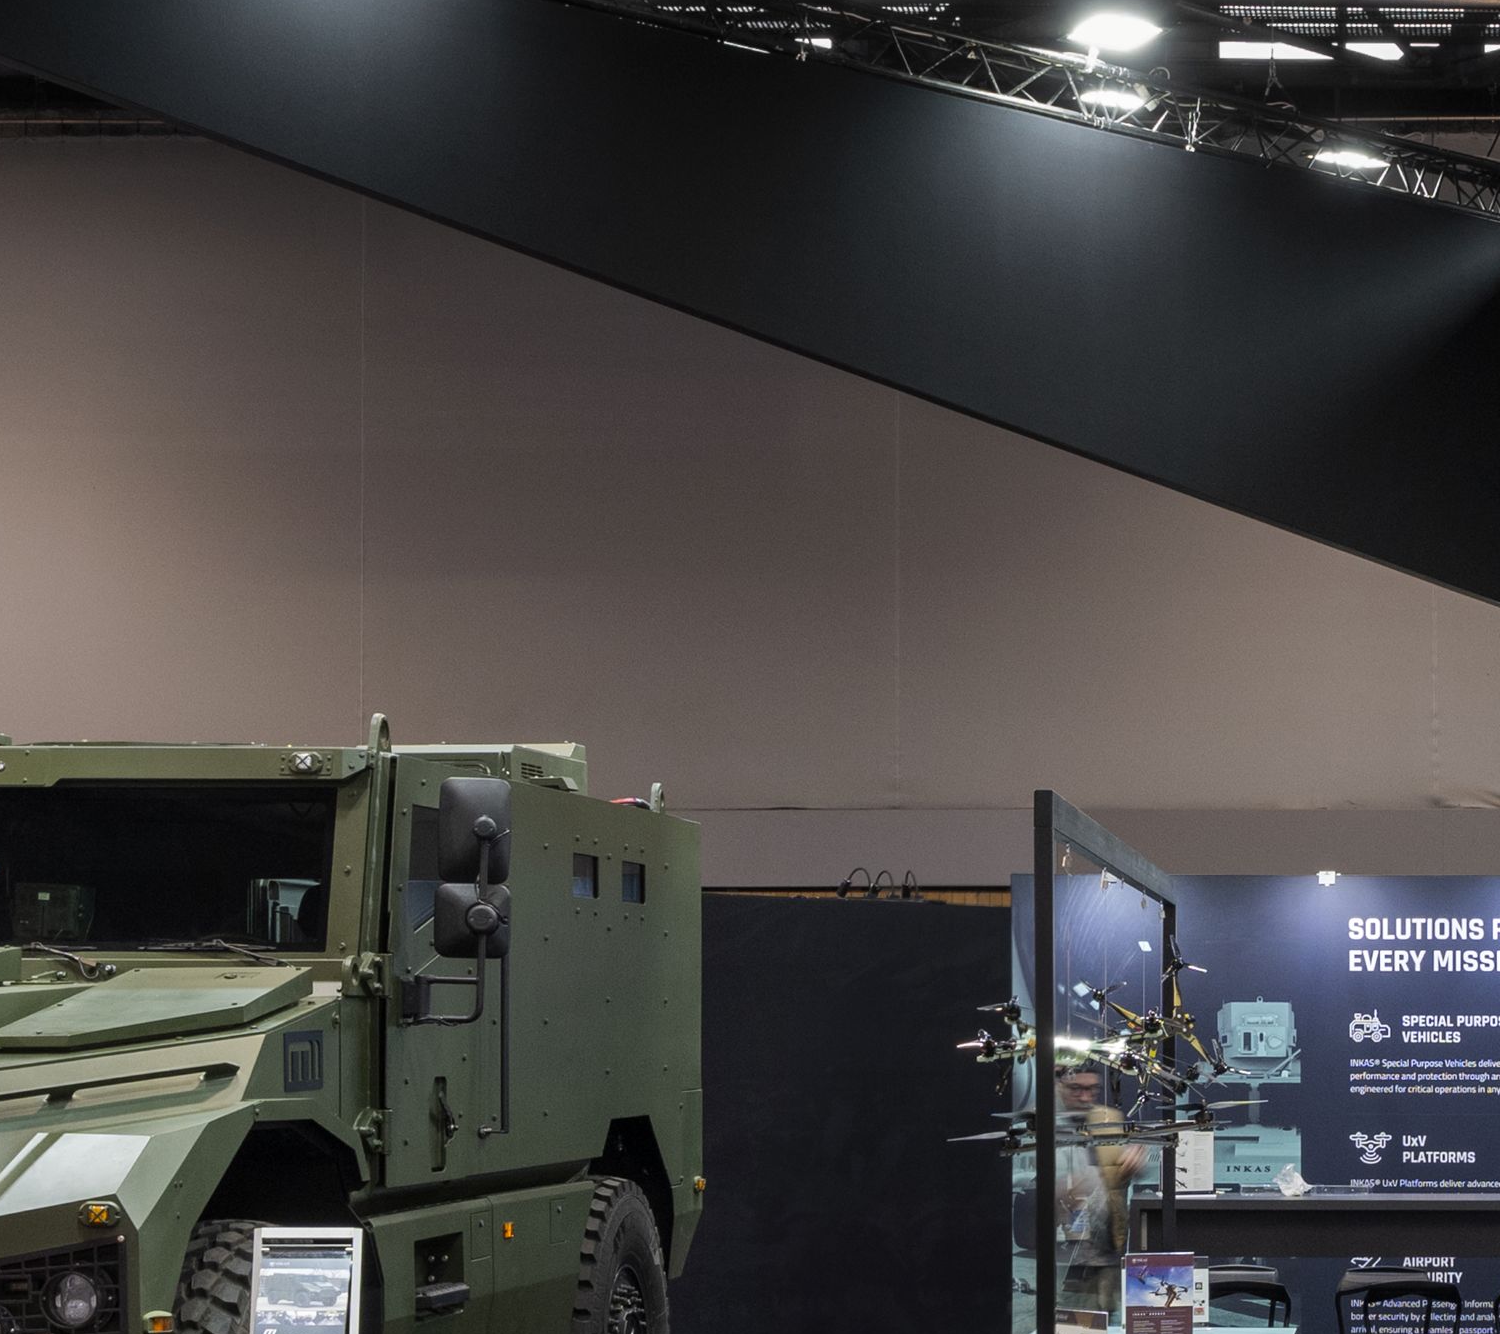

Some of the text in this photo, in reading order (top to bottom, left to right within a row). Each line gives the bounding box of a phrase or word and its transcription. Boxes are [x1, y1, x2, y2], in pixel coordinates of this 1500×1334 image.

[1348, 917, 1485, 941] SOLUTIONS
[1349, 950, 1427, 972] EVERY
[1402, 1015, 1454, 1027] SPECIAL
[1402, 1031, 1461, 1043] VEHICLES
[1381, 1059, 1410, 1070] Special
[1411, 1059, 1444, 1070] Purpose
[1444, 1059, 1477, 1068] Vehicles
[1350, 1072, 1400, 1083] performance
[1401, 1072, 1416, 1081] and
[1417, 1072, 1458, 1083] protection
[1458, 1072, 1490, 1083] through
[1350, 1085, 1394, 1096] engineered
[1395, 1085, 1407, 1094] for
[1408, 1085, 1434, 1094] critical
[1434, 1085, 1477, 1095] operations
[1478, 1085, 1486, 1094] in
[1486, 1087, 1500, 1096] any
[1402, 1134, 1427, 1147] UxV
[1402, 1151, 1476, 1163] PLATFORMS
[1226, 1165, 1271, 1173] INKAS
[1382, 1179, 1398, 1187] UxV
[1399, 1178, 1439, 1188] Platforms
[1439, 1178, 1465, 1188] deliver
[1403, 1256, 1456, 1267] AIRPORT
[1382, 1299, 1420, 1308] Advanced
[1378, 1313, 1409, 1322] security
[1410, 1313, 1420, 1323] by
[1460, 1313, 1475, 1321] and
